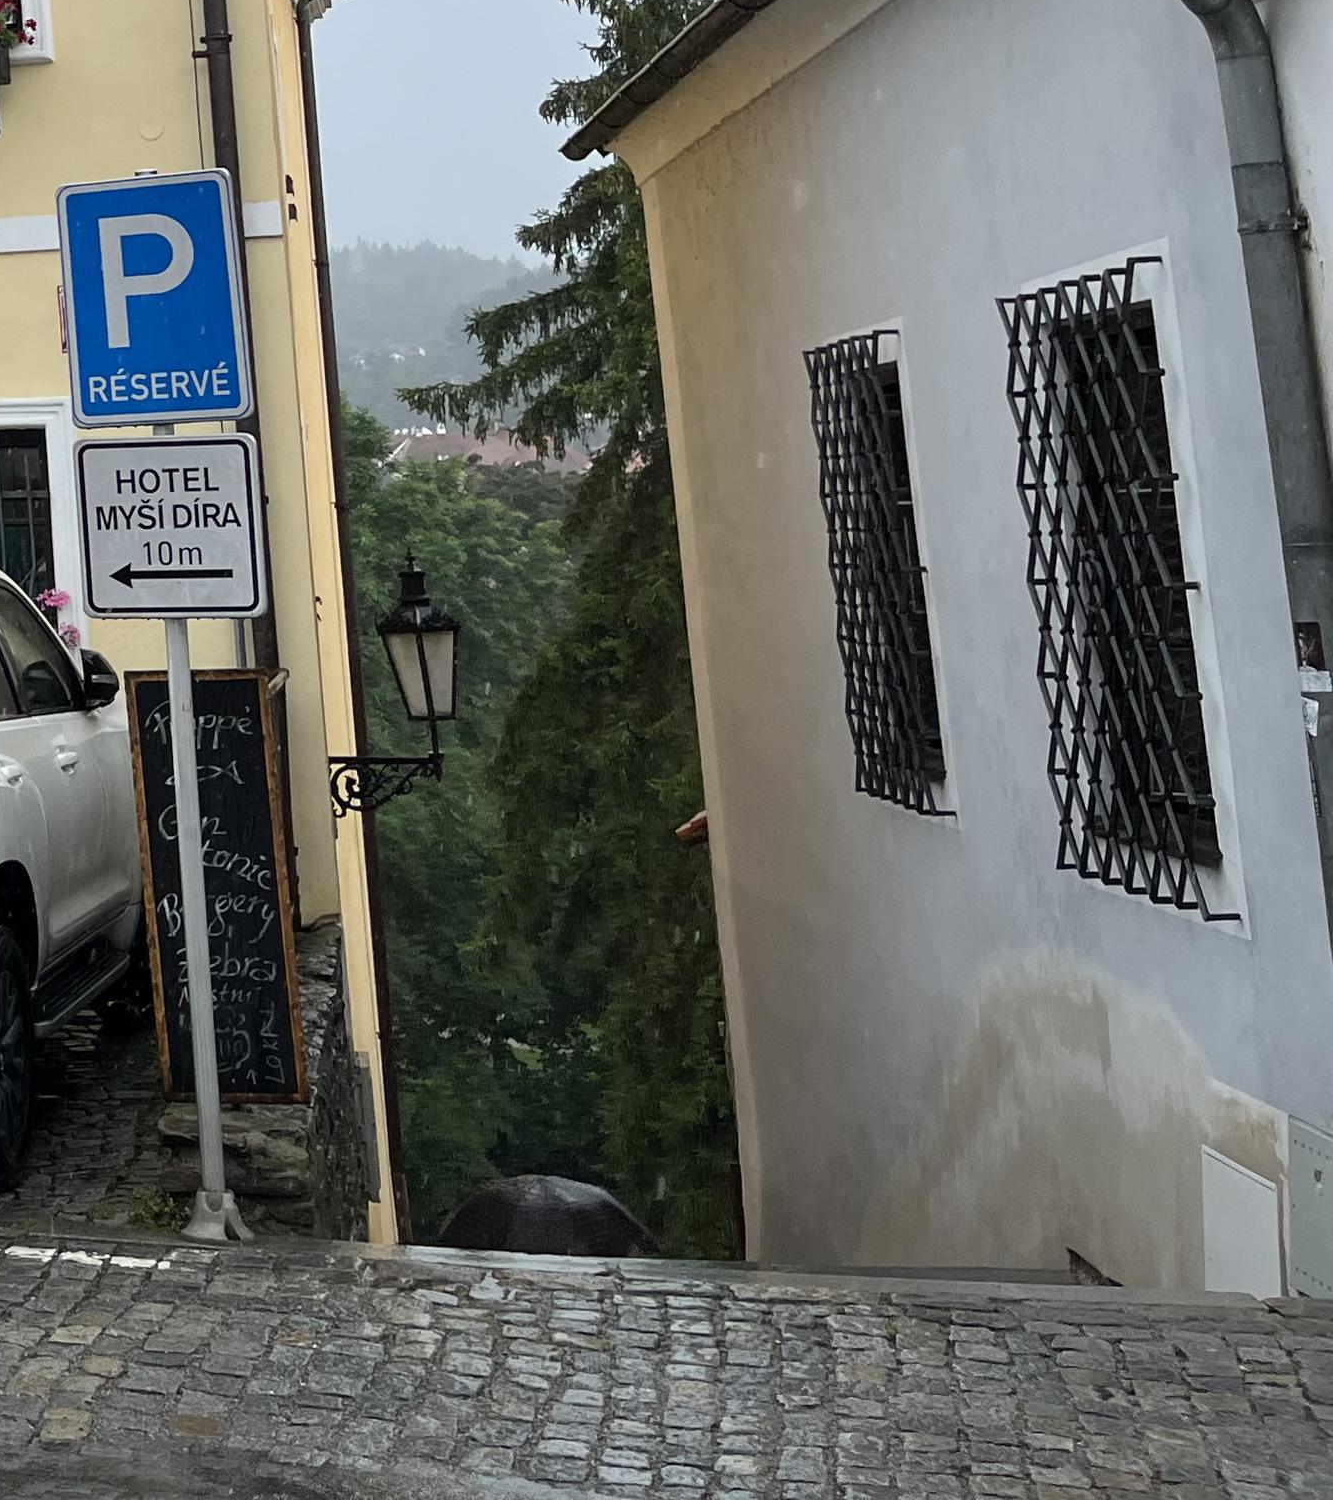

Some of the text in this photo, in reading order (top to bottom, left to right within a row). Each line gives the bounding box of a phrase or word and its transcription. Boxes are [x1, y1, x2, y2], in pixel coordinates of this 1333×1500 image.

[98, 212, 195, 350] P
[88, 361, 231, 403] RÉSERVÉ
[116, 467, 220, 495] HOTEL
[96, 498, 241, 531] MYŠÍ DÍRA
